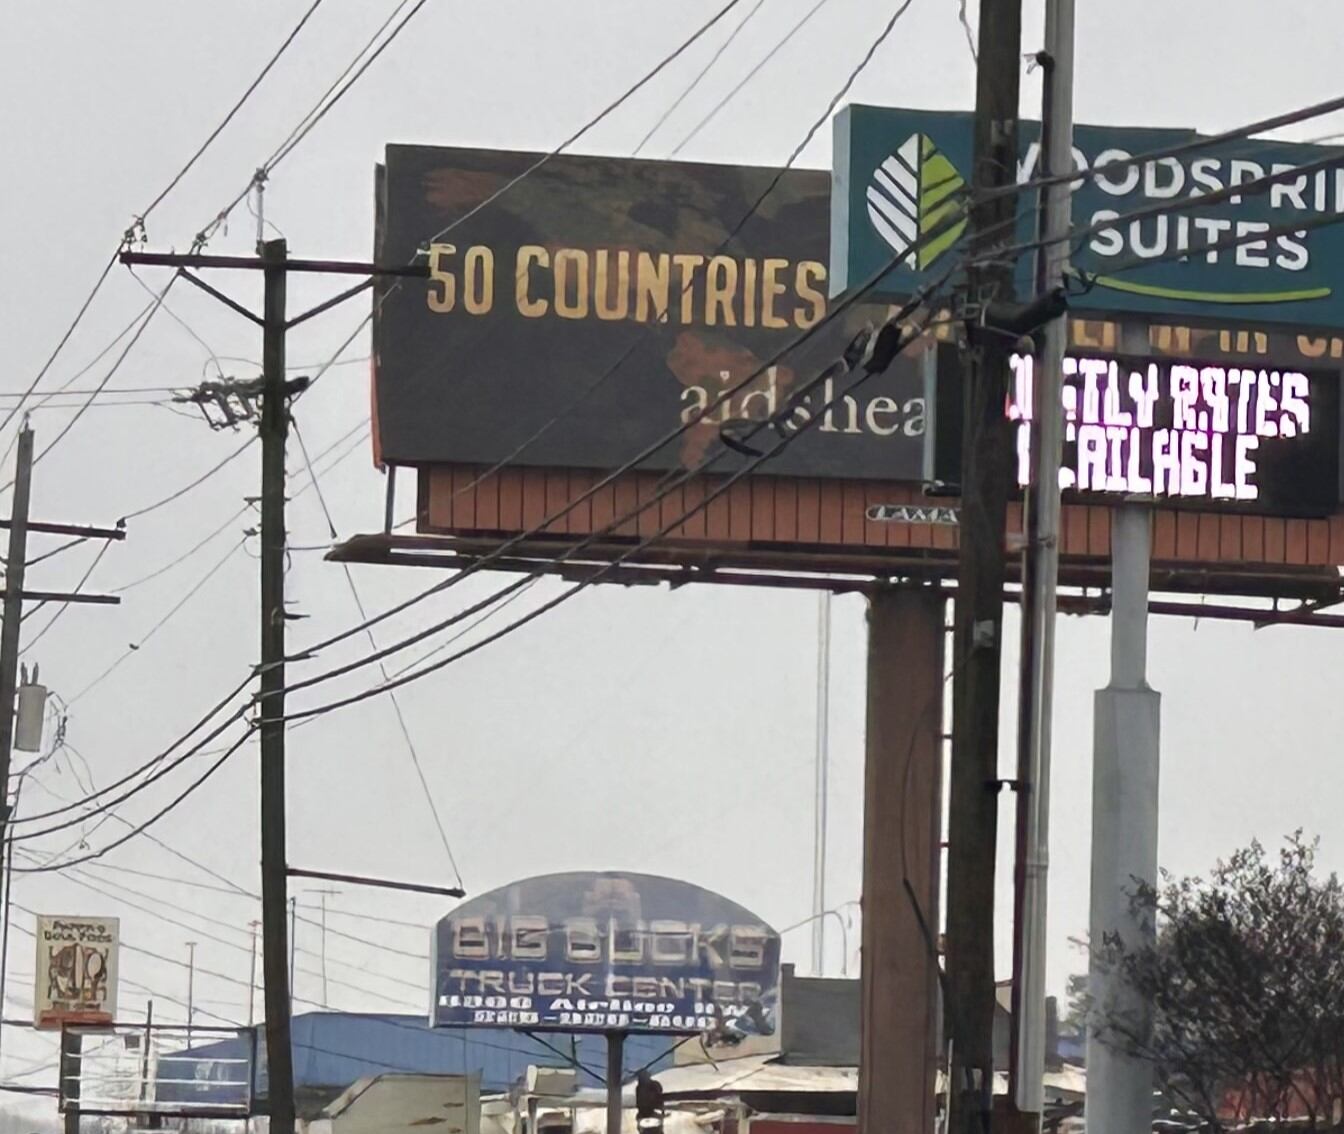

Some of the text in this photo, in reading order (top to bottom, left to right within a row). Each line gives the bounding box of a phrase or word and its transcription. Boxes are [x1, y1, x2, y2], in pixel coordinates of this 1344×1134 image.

[1089, 208, 1310, 272] SUITES
[426, 243, 495, 315] 50
[514, 244, 830, 330] COUNTRIES
[680, 364, 925, 437] aidshea
[452, 914, 549, 962] BIG
[449, 967, 763, 1004] TRUCK CENTER
